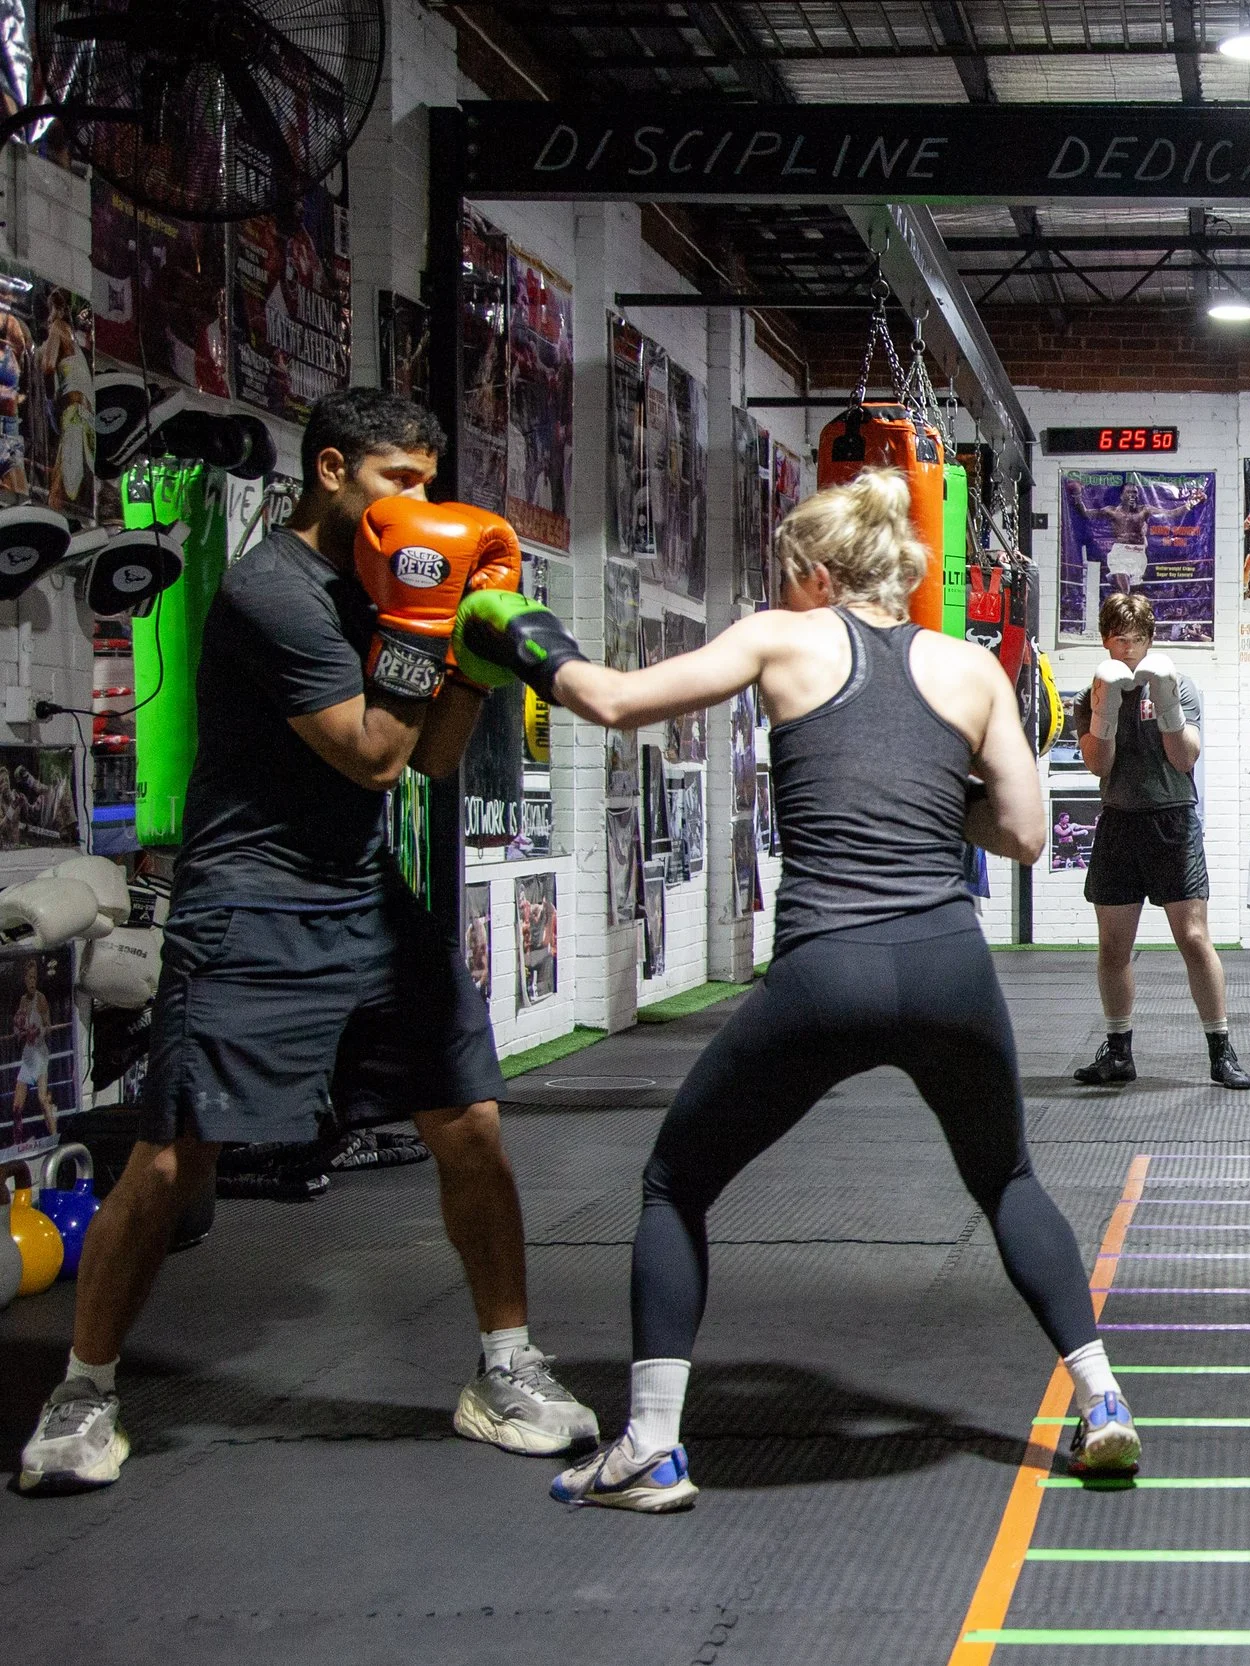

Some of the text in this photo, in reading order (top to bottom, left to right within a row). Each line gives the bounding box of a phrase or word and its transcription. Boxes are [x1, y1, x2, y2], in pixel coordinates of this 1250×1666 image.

[532, 124, 950, 180] DISCIPLINE
[1100, 430, 1172, 449] 6 25 50
[1066, 470, 1123, 487] Sports
[396, 553, 444, 584] REYES
[373, 650, 436, 690] REYES
[509, 801, 518, 837] IS
